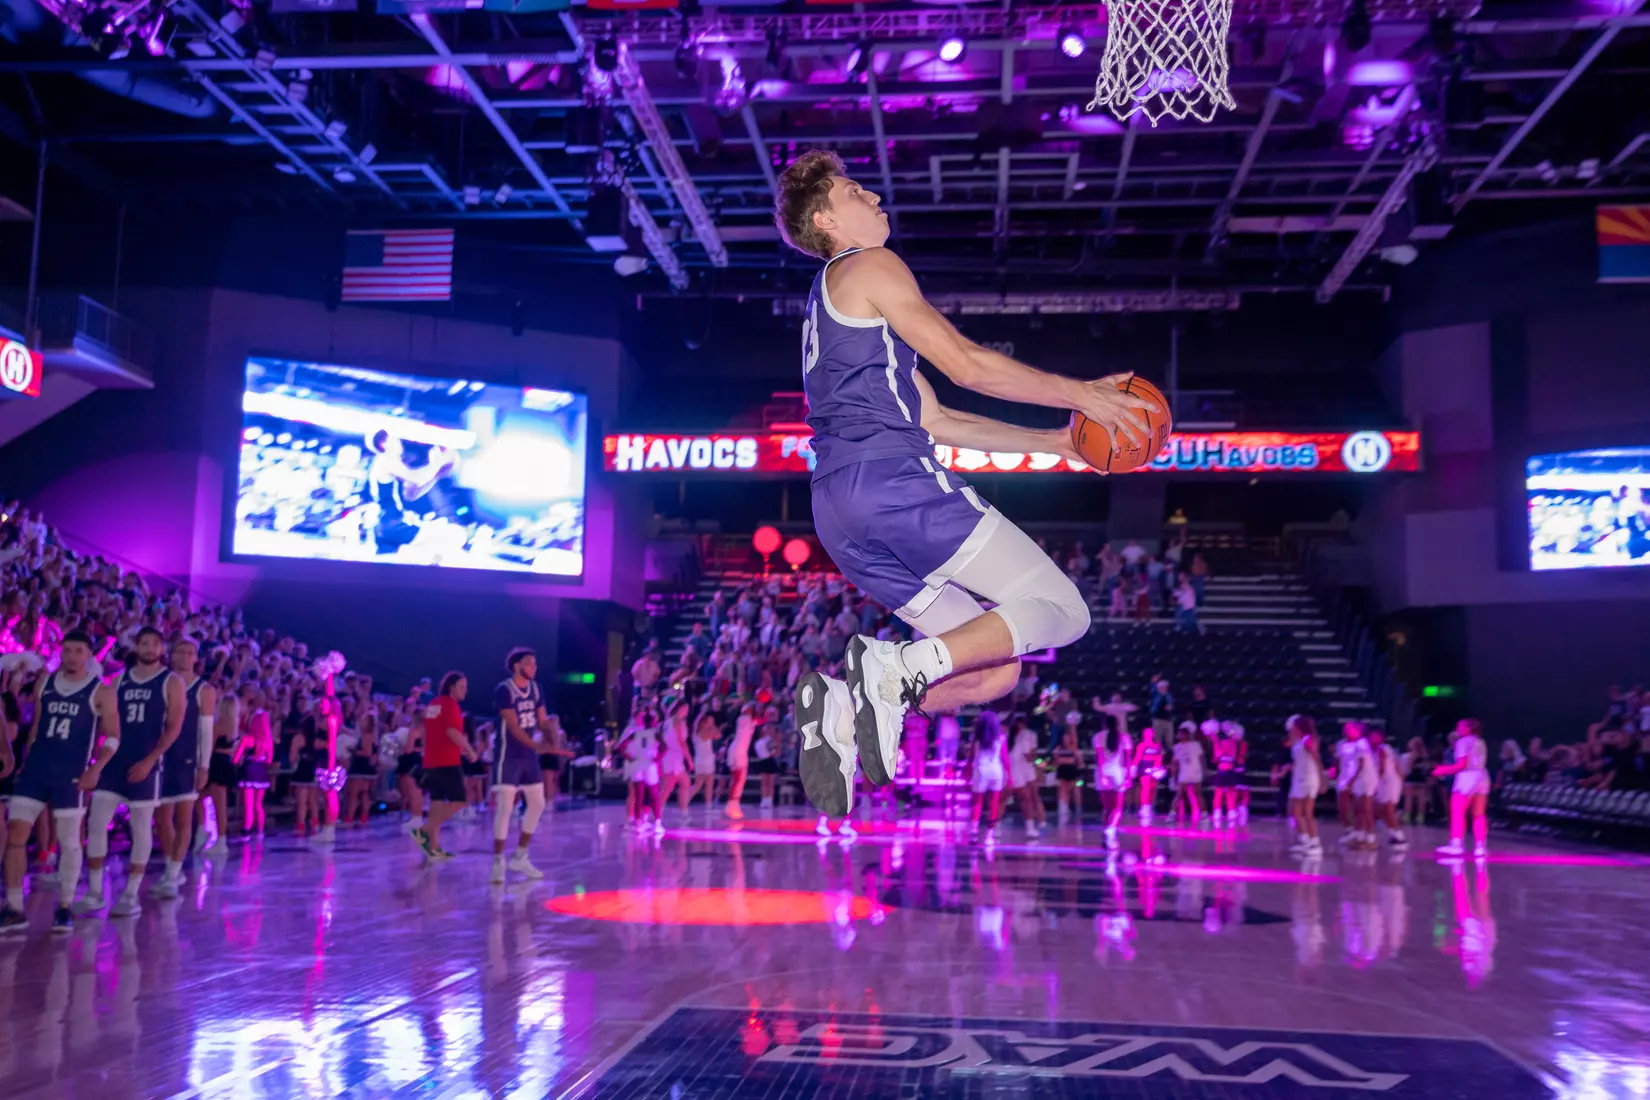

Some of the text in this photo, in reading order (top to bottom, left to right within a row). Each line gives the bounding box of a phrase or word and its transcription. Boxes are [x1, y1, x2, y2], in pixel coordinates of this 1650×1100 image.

[124, 689, 152, 701] GCU
[48, 702, 80, 716] GCU
[126, 703, 146, 723] 31
[46, 717, 72, 740] 14
